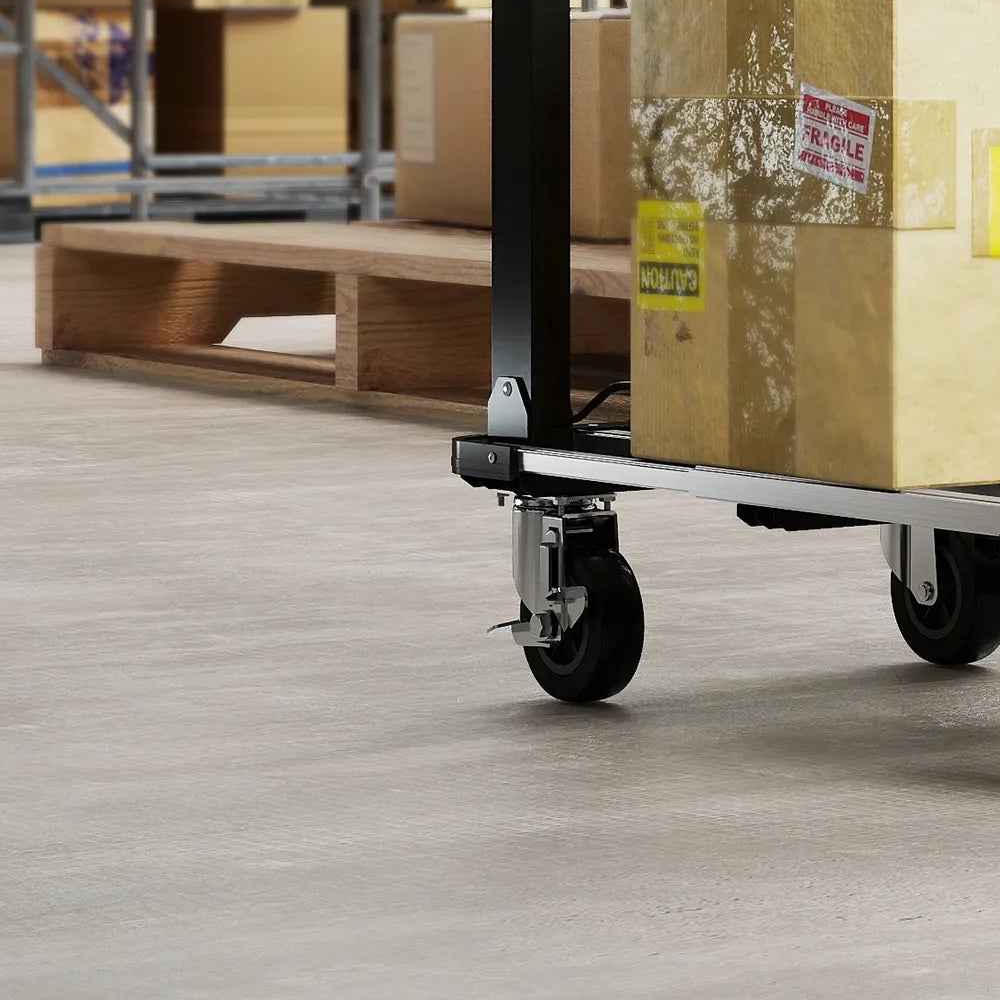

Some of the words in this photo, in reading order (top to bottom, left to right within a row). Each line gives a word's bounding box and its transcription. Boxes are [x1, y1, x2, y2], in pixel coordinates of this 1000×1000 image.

[847, 120, 865, 134] CARE
[802, 124, 865, 162] FRAGILE
[640, 266, 699, 293] CAUTION
